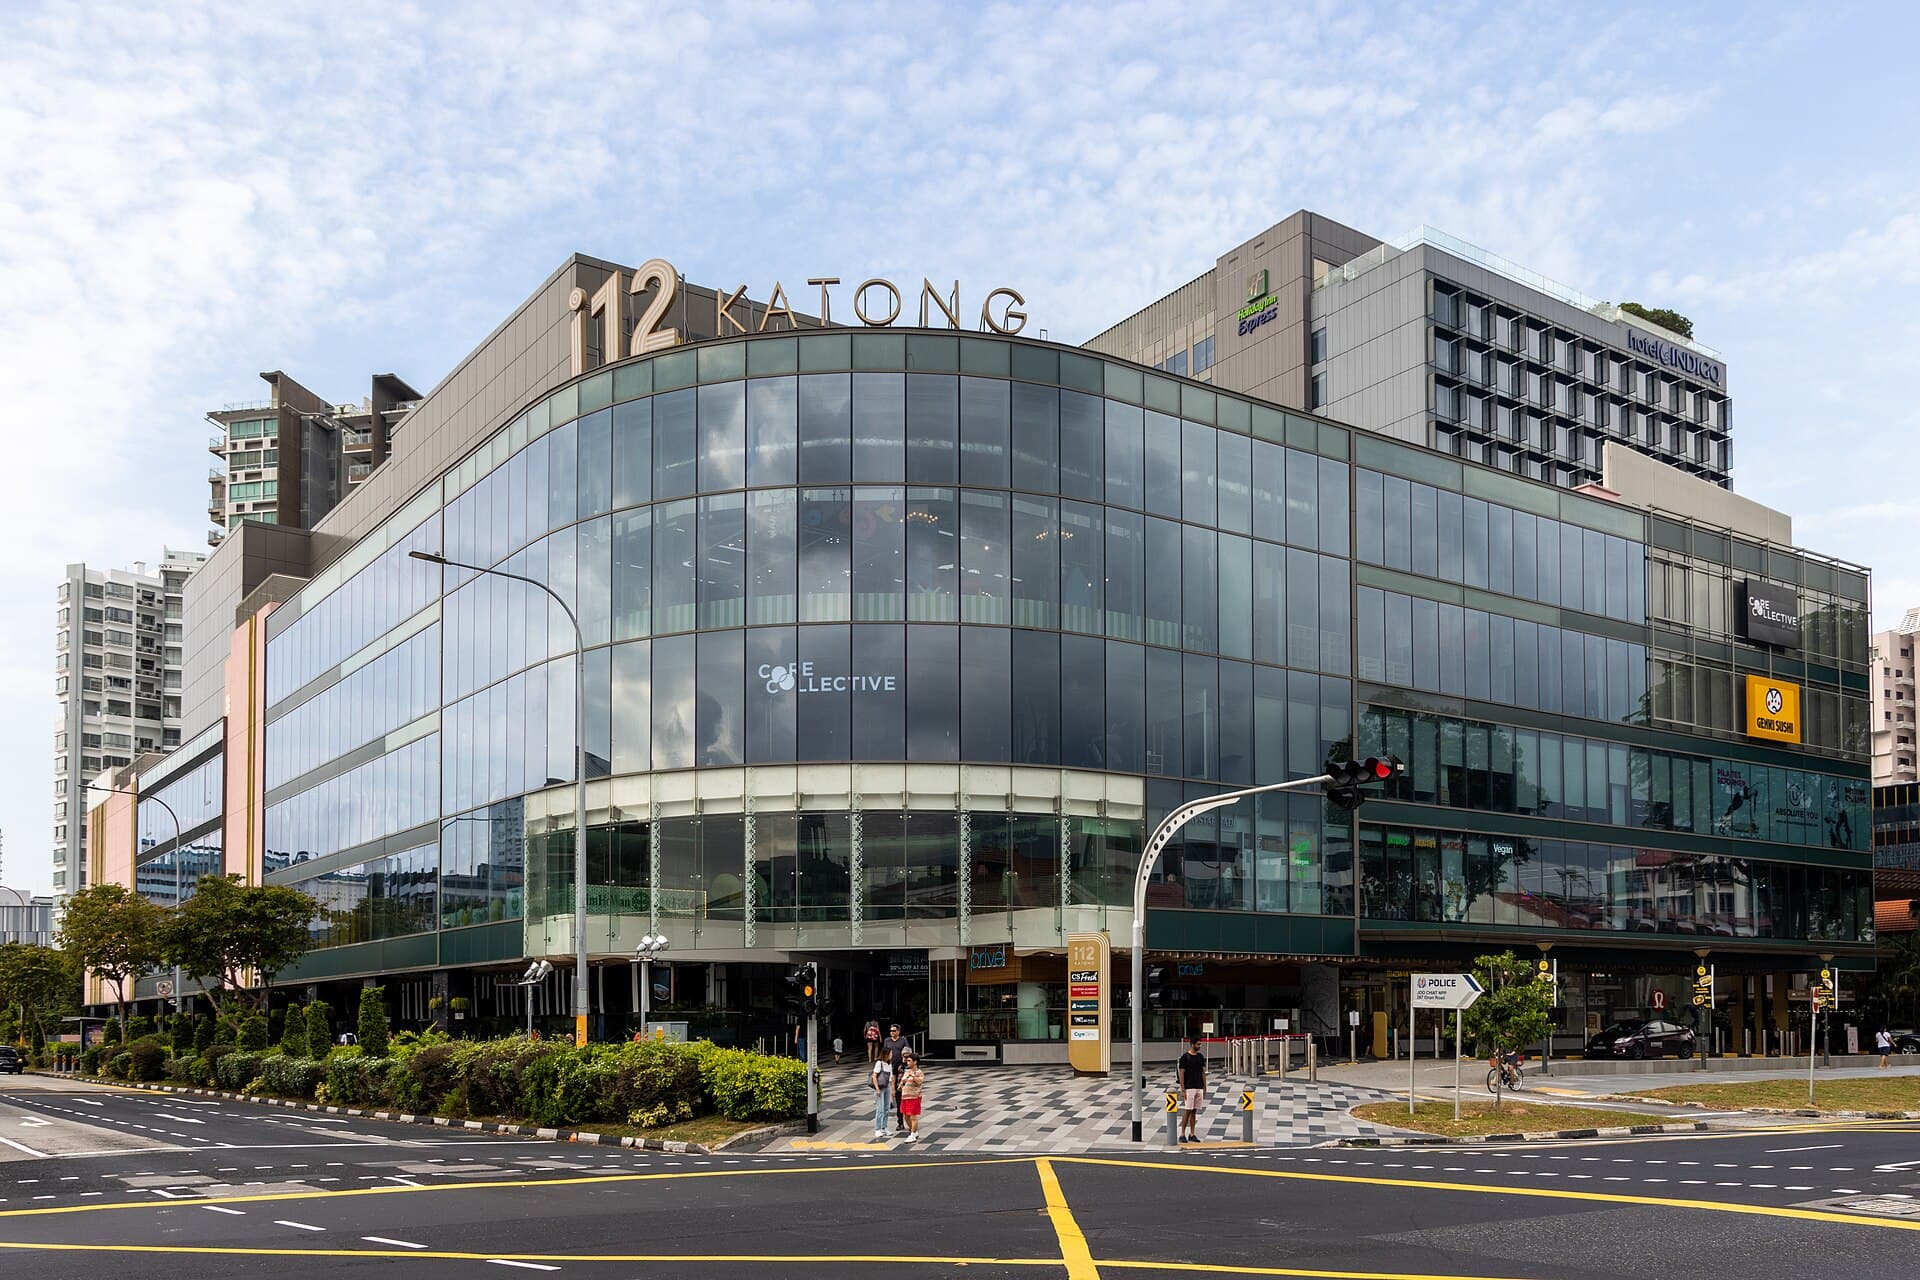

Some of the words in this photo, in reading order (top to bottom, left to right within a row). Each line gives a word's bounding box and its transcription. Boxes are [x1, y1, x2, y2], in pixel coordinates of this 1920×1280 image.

[568, 257, 681, 377] i12
[715, 277, 1028, 337] KATONG
[1237, 302, 1265, 321] Holiday
[1238, 307, 1278, 336] Express
[1627, 328, 1659, 360] hotel
[1670, 346, 1721, 386] INDIGO
[1752, 607, 1797, 626] COLLECTIVE
[1756, 717, 1775, 731] GENKI
[1776, 720, 1794, 734] SUSHI
[1493, 843, 1513, 856] Vegan
[1073, 946, 1095, 961] i12
[1071, 973, 1081, 981] CS
[1428, 979, 1457, 987] POLICE
